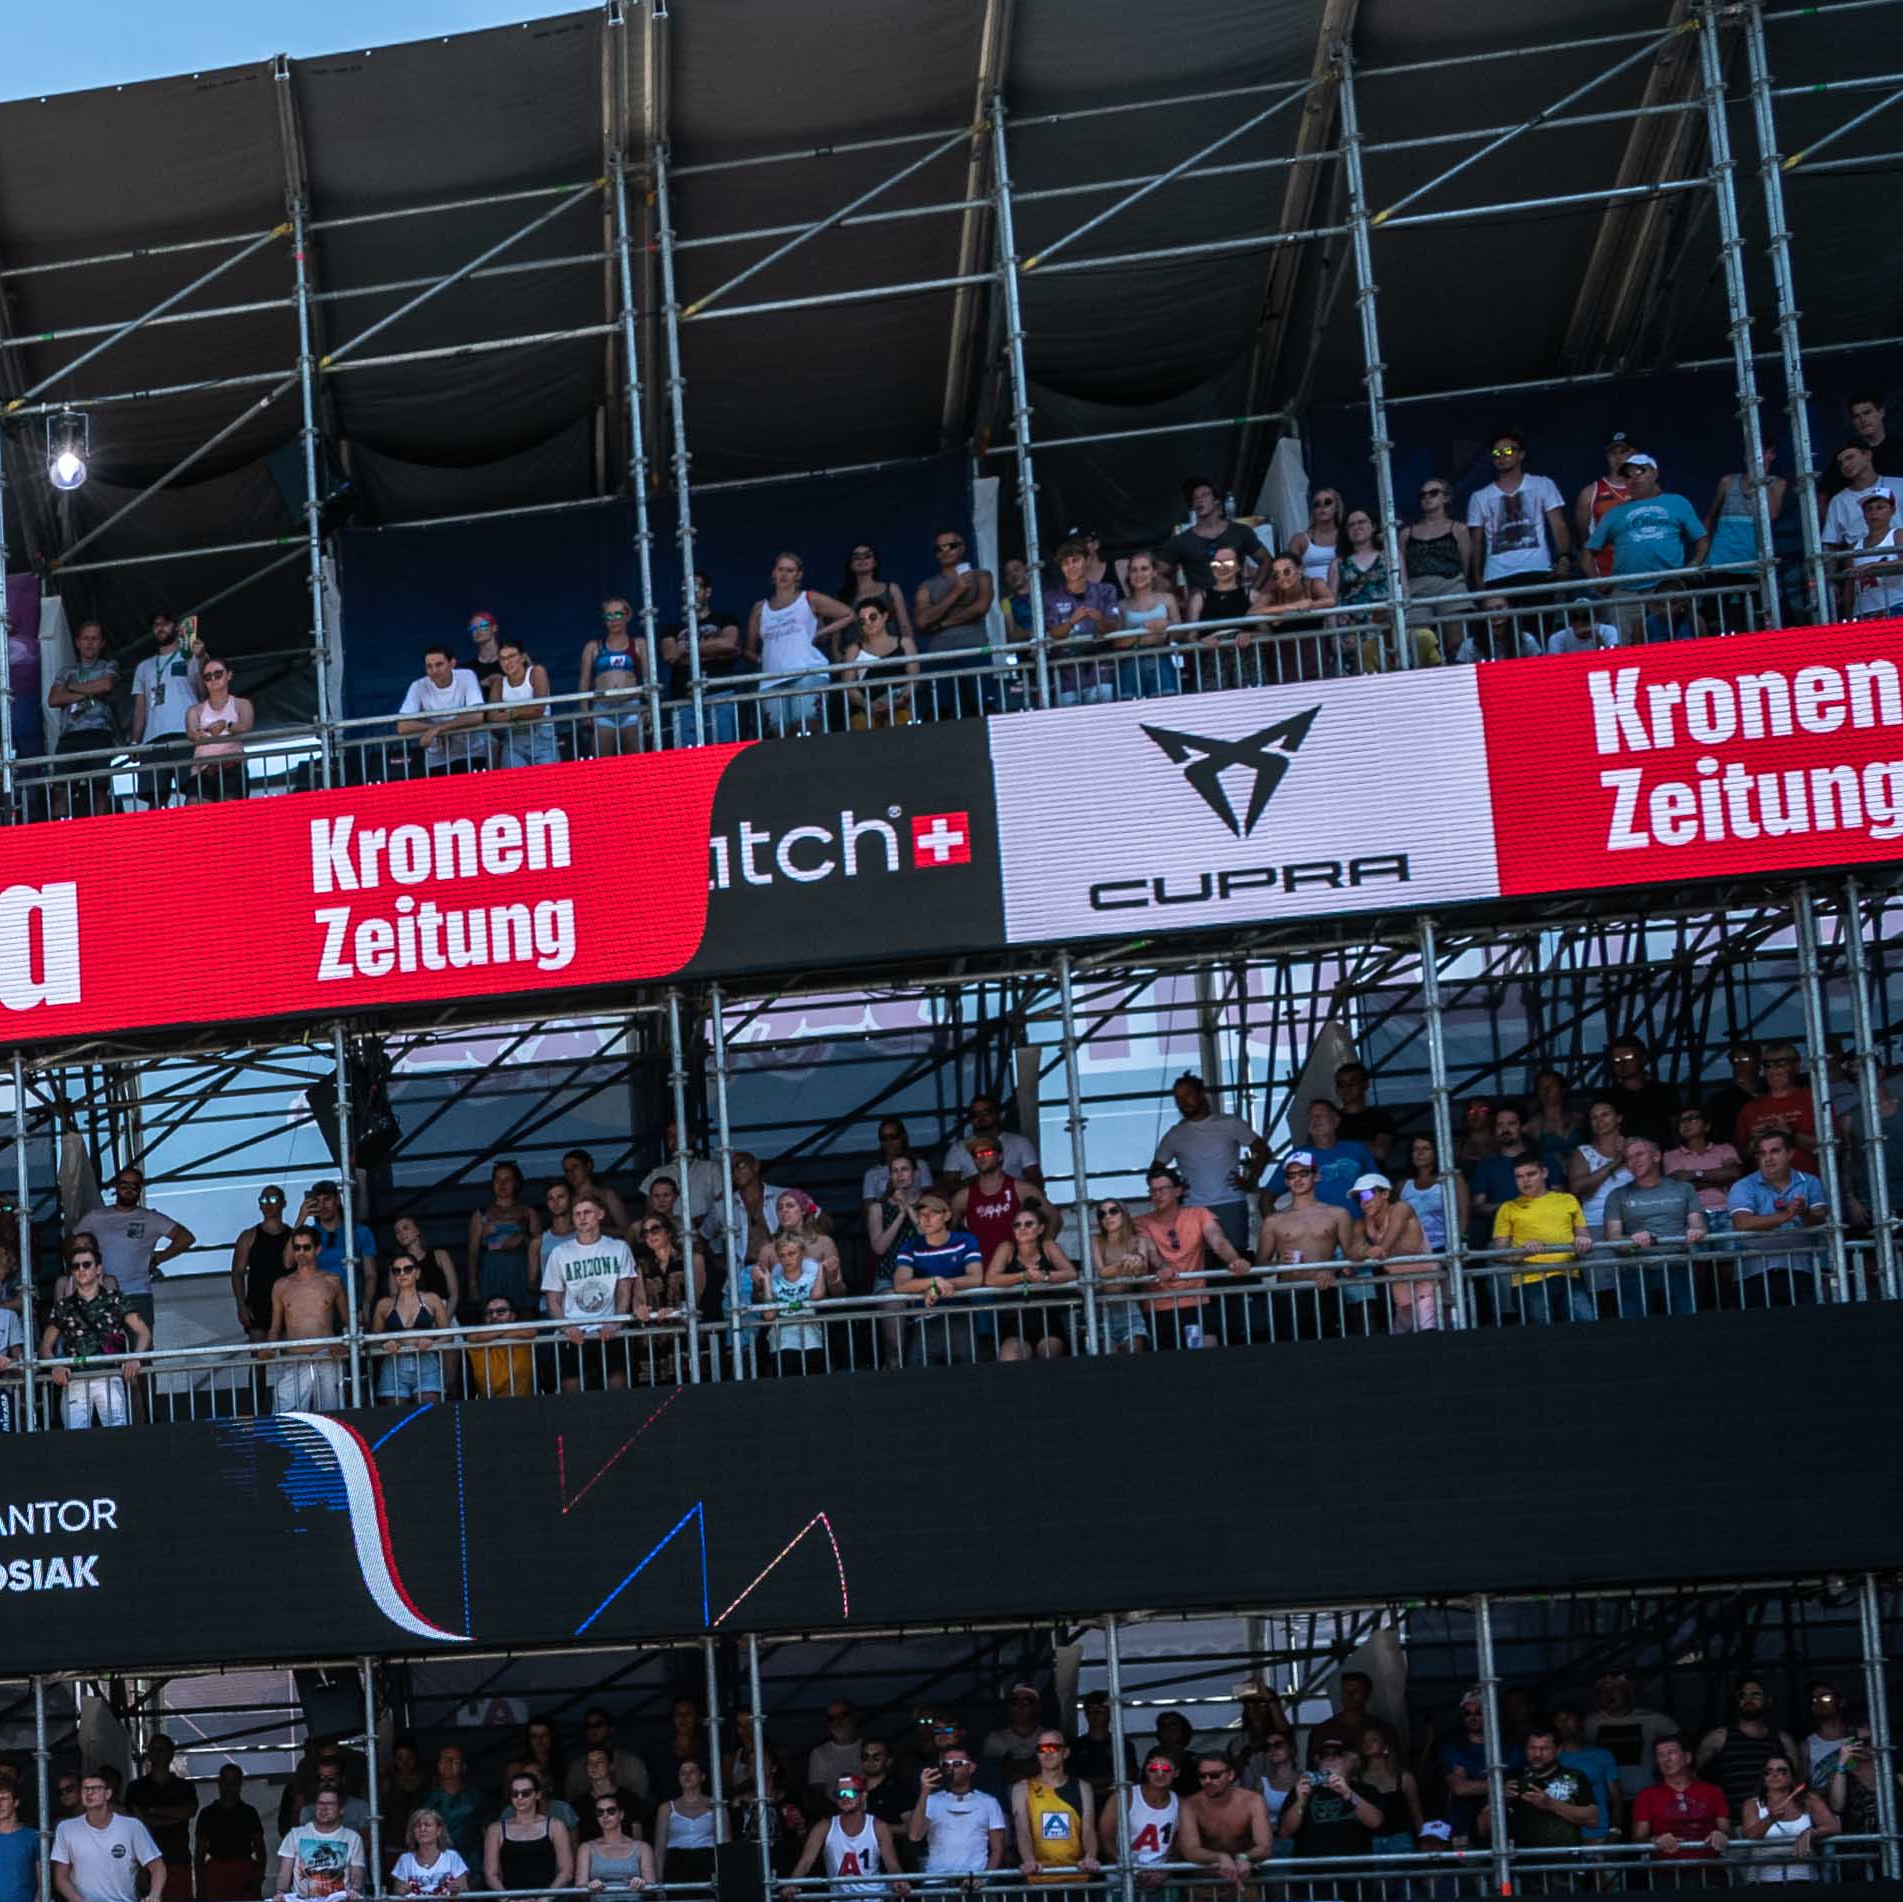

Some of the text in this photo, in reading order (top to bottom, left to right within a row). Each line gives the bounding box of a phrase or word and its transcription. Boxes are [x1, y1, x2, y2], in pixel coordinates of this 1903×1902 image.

[1588, 657, 1903, 754] Kronen
[1598, 754, 1903, 855] Zeitung
[311, 806, 571, 894] Kronen
[1088, 852, 1411, 912] CUPRA
[314, 895, 575, 981] Zeitung
[566, 1255, 620, 1281] ARIZONA
[838, 1847, 871, 1876] A1
[1131, 1823, 1172, 1853] A1
